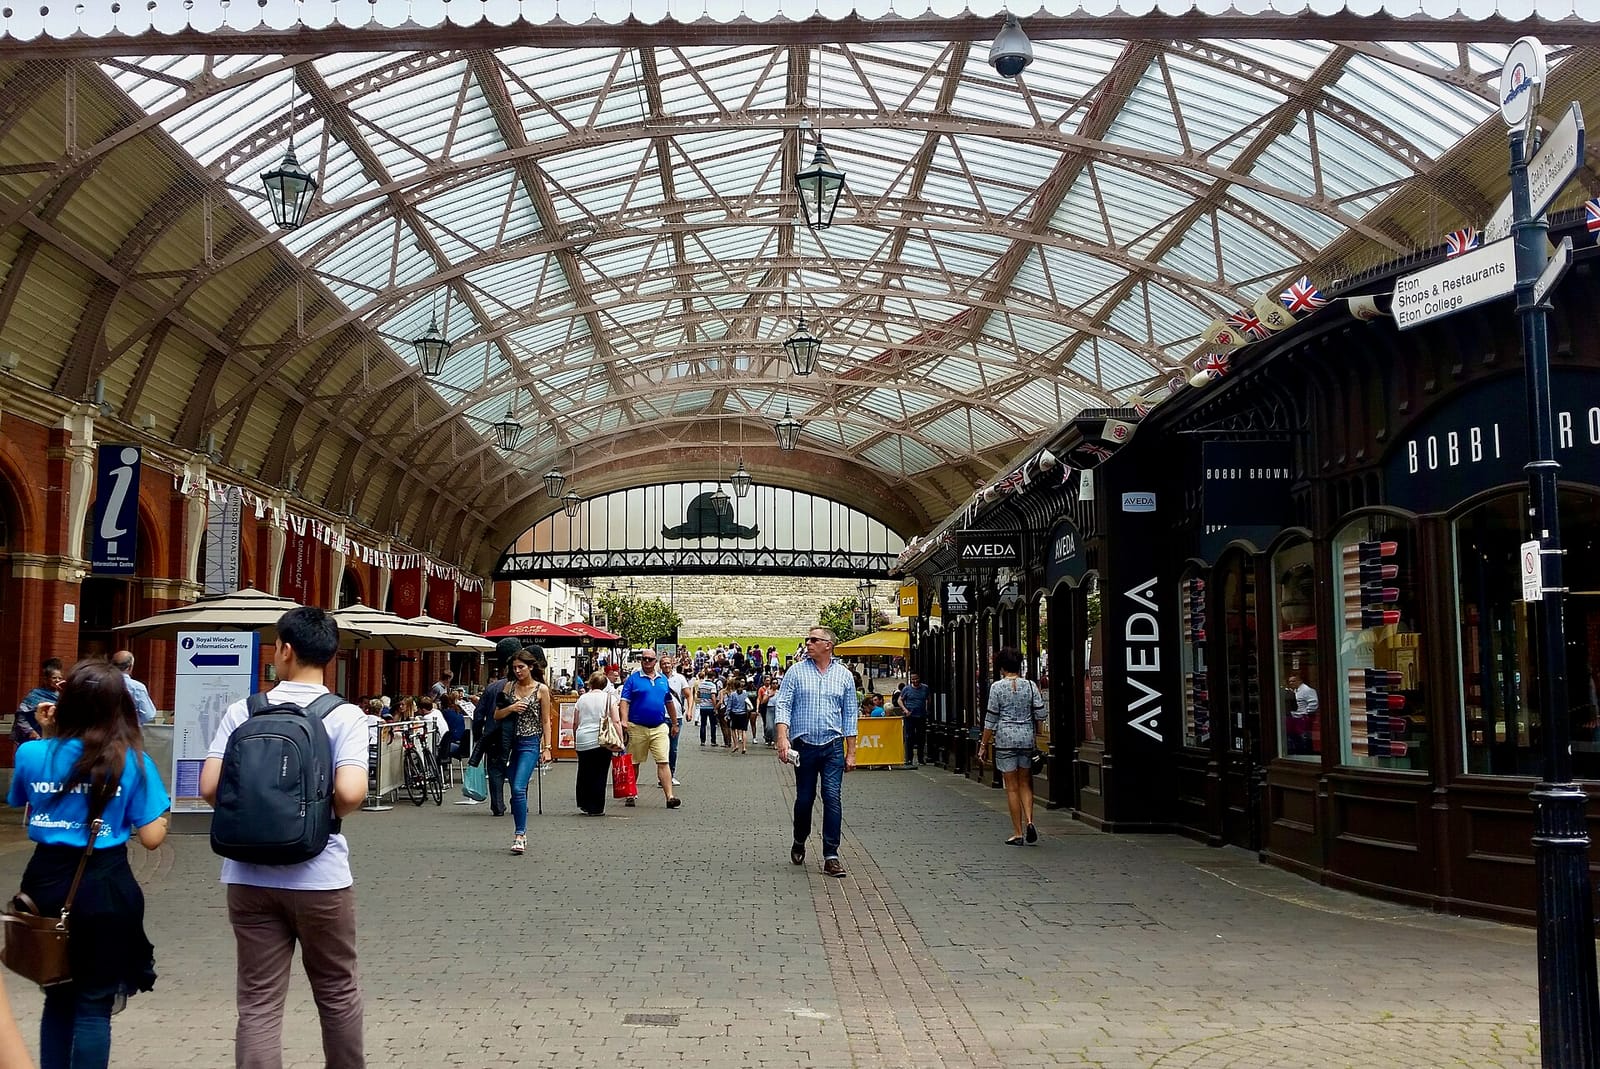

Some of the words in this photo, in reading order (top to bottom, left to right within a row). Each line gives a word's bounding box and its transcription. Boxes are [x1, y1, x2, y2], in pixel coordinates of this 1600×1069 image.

[1397, 277, 1420, 294] Eton
[1398, 289, 1430, 308] Shops
[1432, 284, 1439, 297] &
[1442, 261, 1506, 293] Restaurants
[1399, 309, 1422, 324] Eton
[1424, 293, 1463, 316] College
[1408, 423, 1500, 474] BOBBI
[1558, 406, 1600, 449] RO
[1206, 468, 1242, 480] BOBBI
[1249, 468, 1289, 479] BROWN
[231, 493, 239, 527] WINDSOR
[1123, 497, 1154, 505] AVEDA
[230, 527, 238, 555] ROYAL
[962, 544, 1016, 556] AVEDA
[1055, 533, 1076, 560] AVEDA
[296, 540, 304, 573] CINNAMON
[229, 556, 237, 589] STATION
[1124, 576, 1163, 742] AVEDA
[856, 735, 883, 748] AT.
